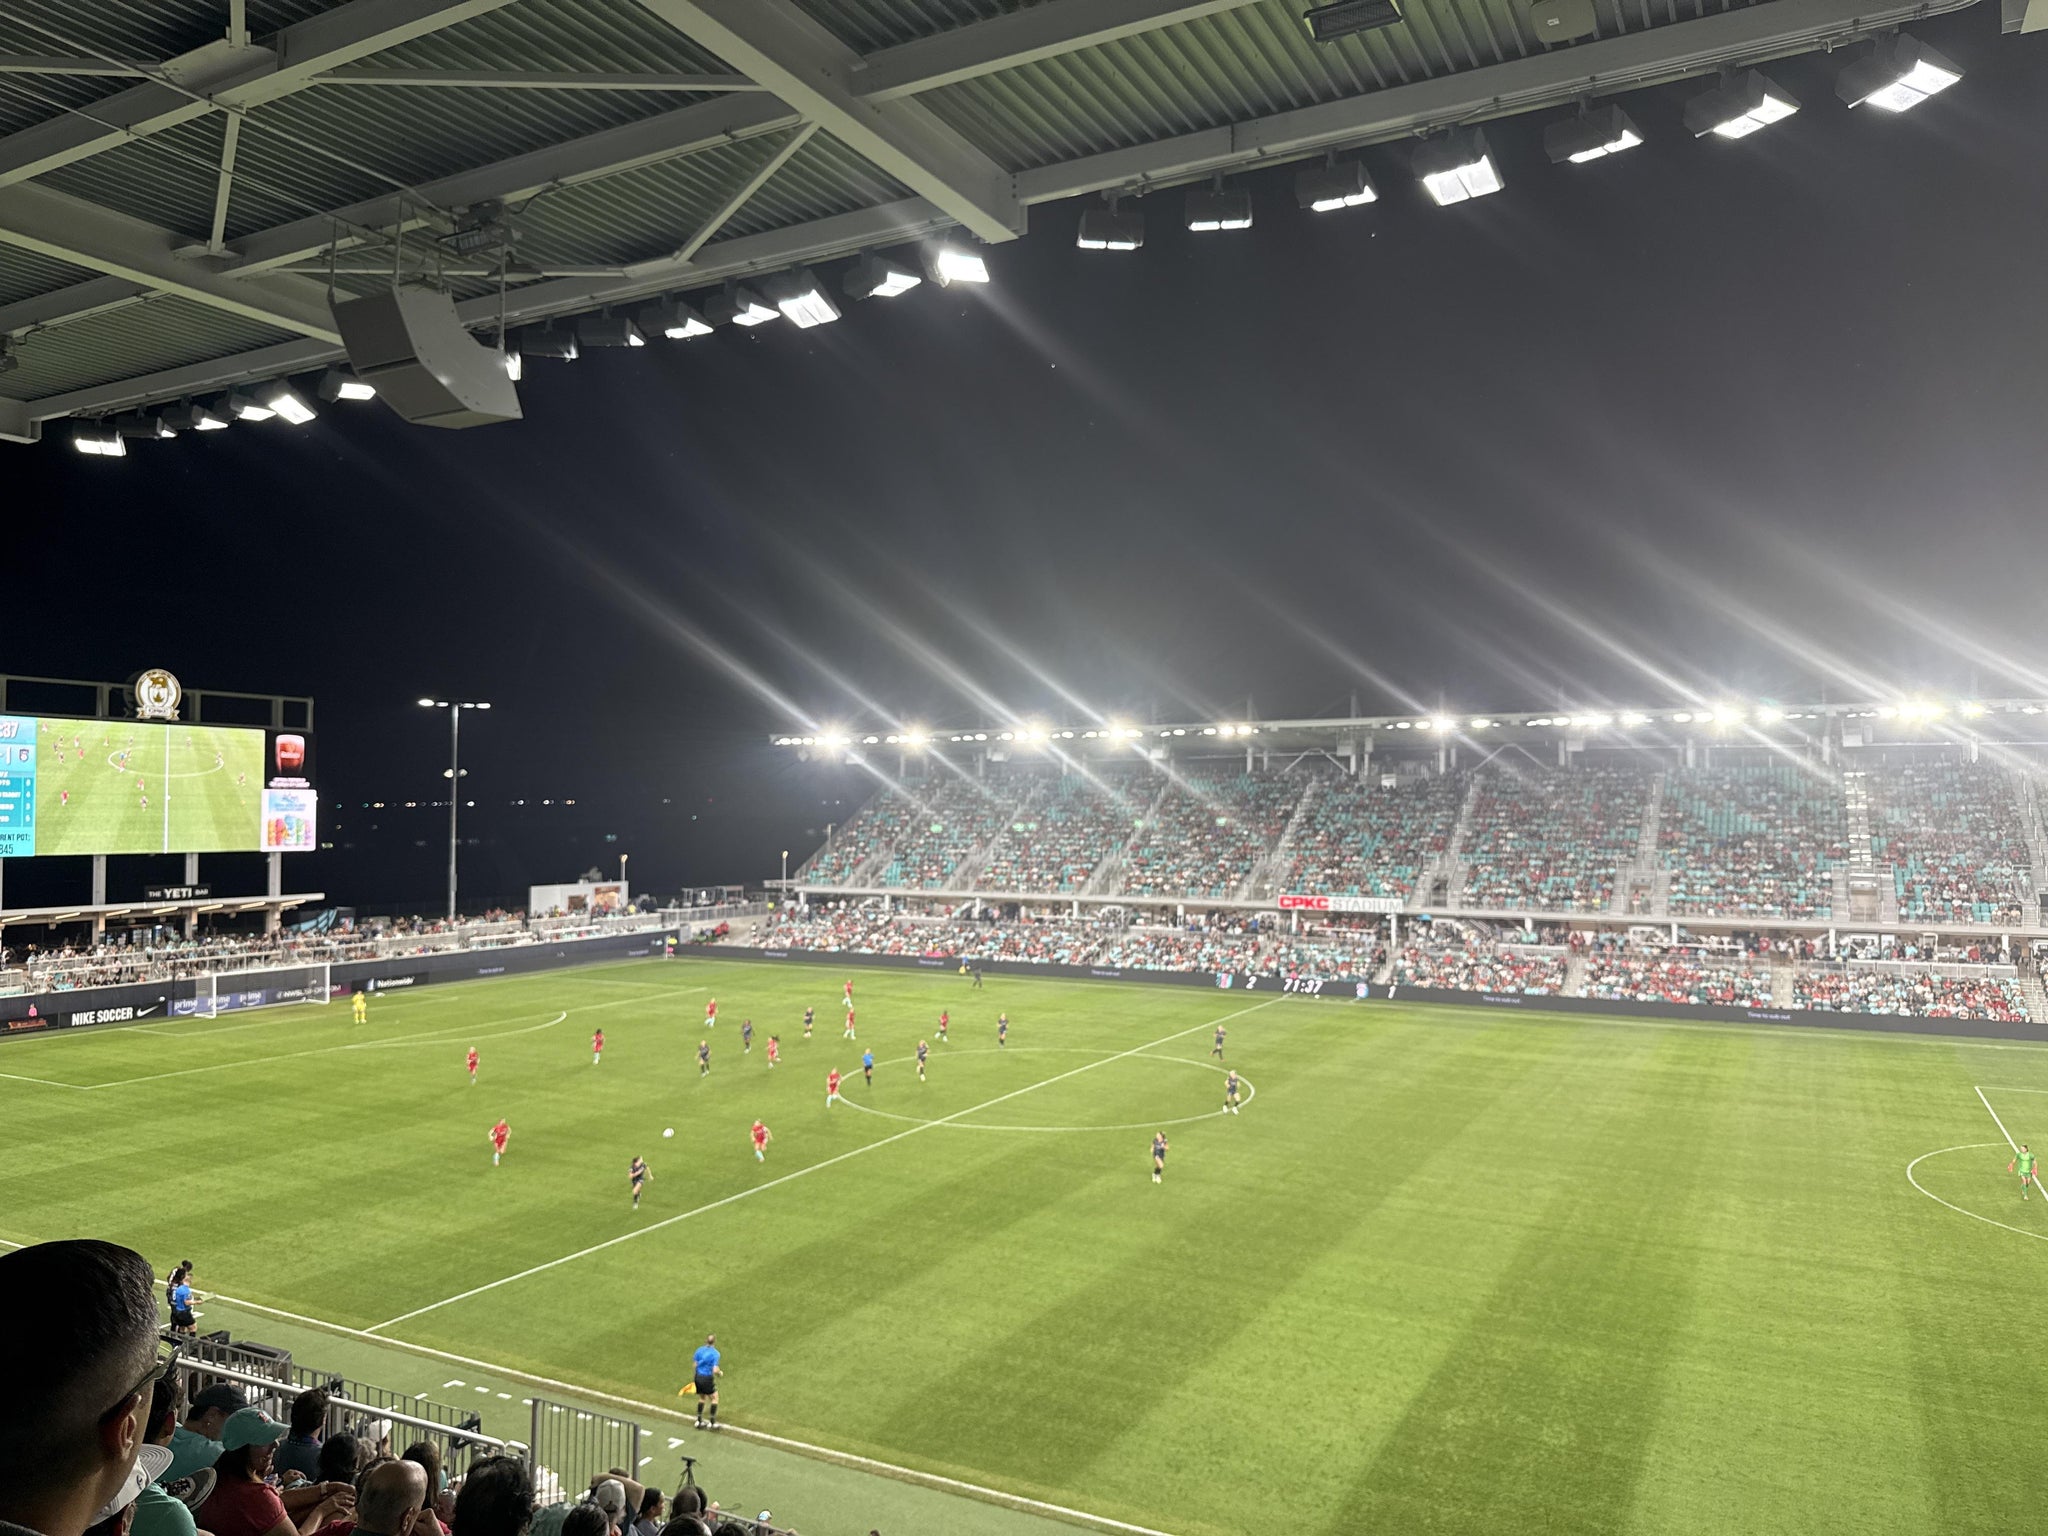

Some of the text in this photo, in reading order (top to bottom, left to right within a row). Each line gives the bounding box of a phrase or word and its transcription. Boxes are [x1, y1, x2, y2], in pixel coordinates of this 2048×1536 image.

[164, 888, 192, 899] YETI
[1279, 896, 1402, 912] CPKC STADIUM
[1246, 976, 1397, 999] 2 71:37 1
[174, 999, 198, 1010] prime
[72, 1006, 133, 1026] NIKE SOCCER
